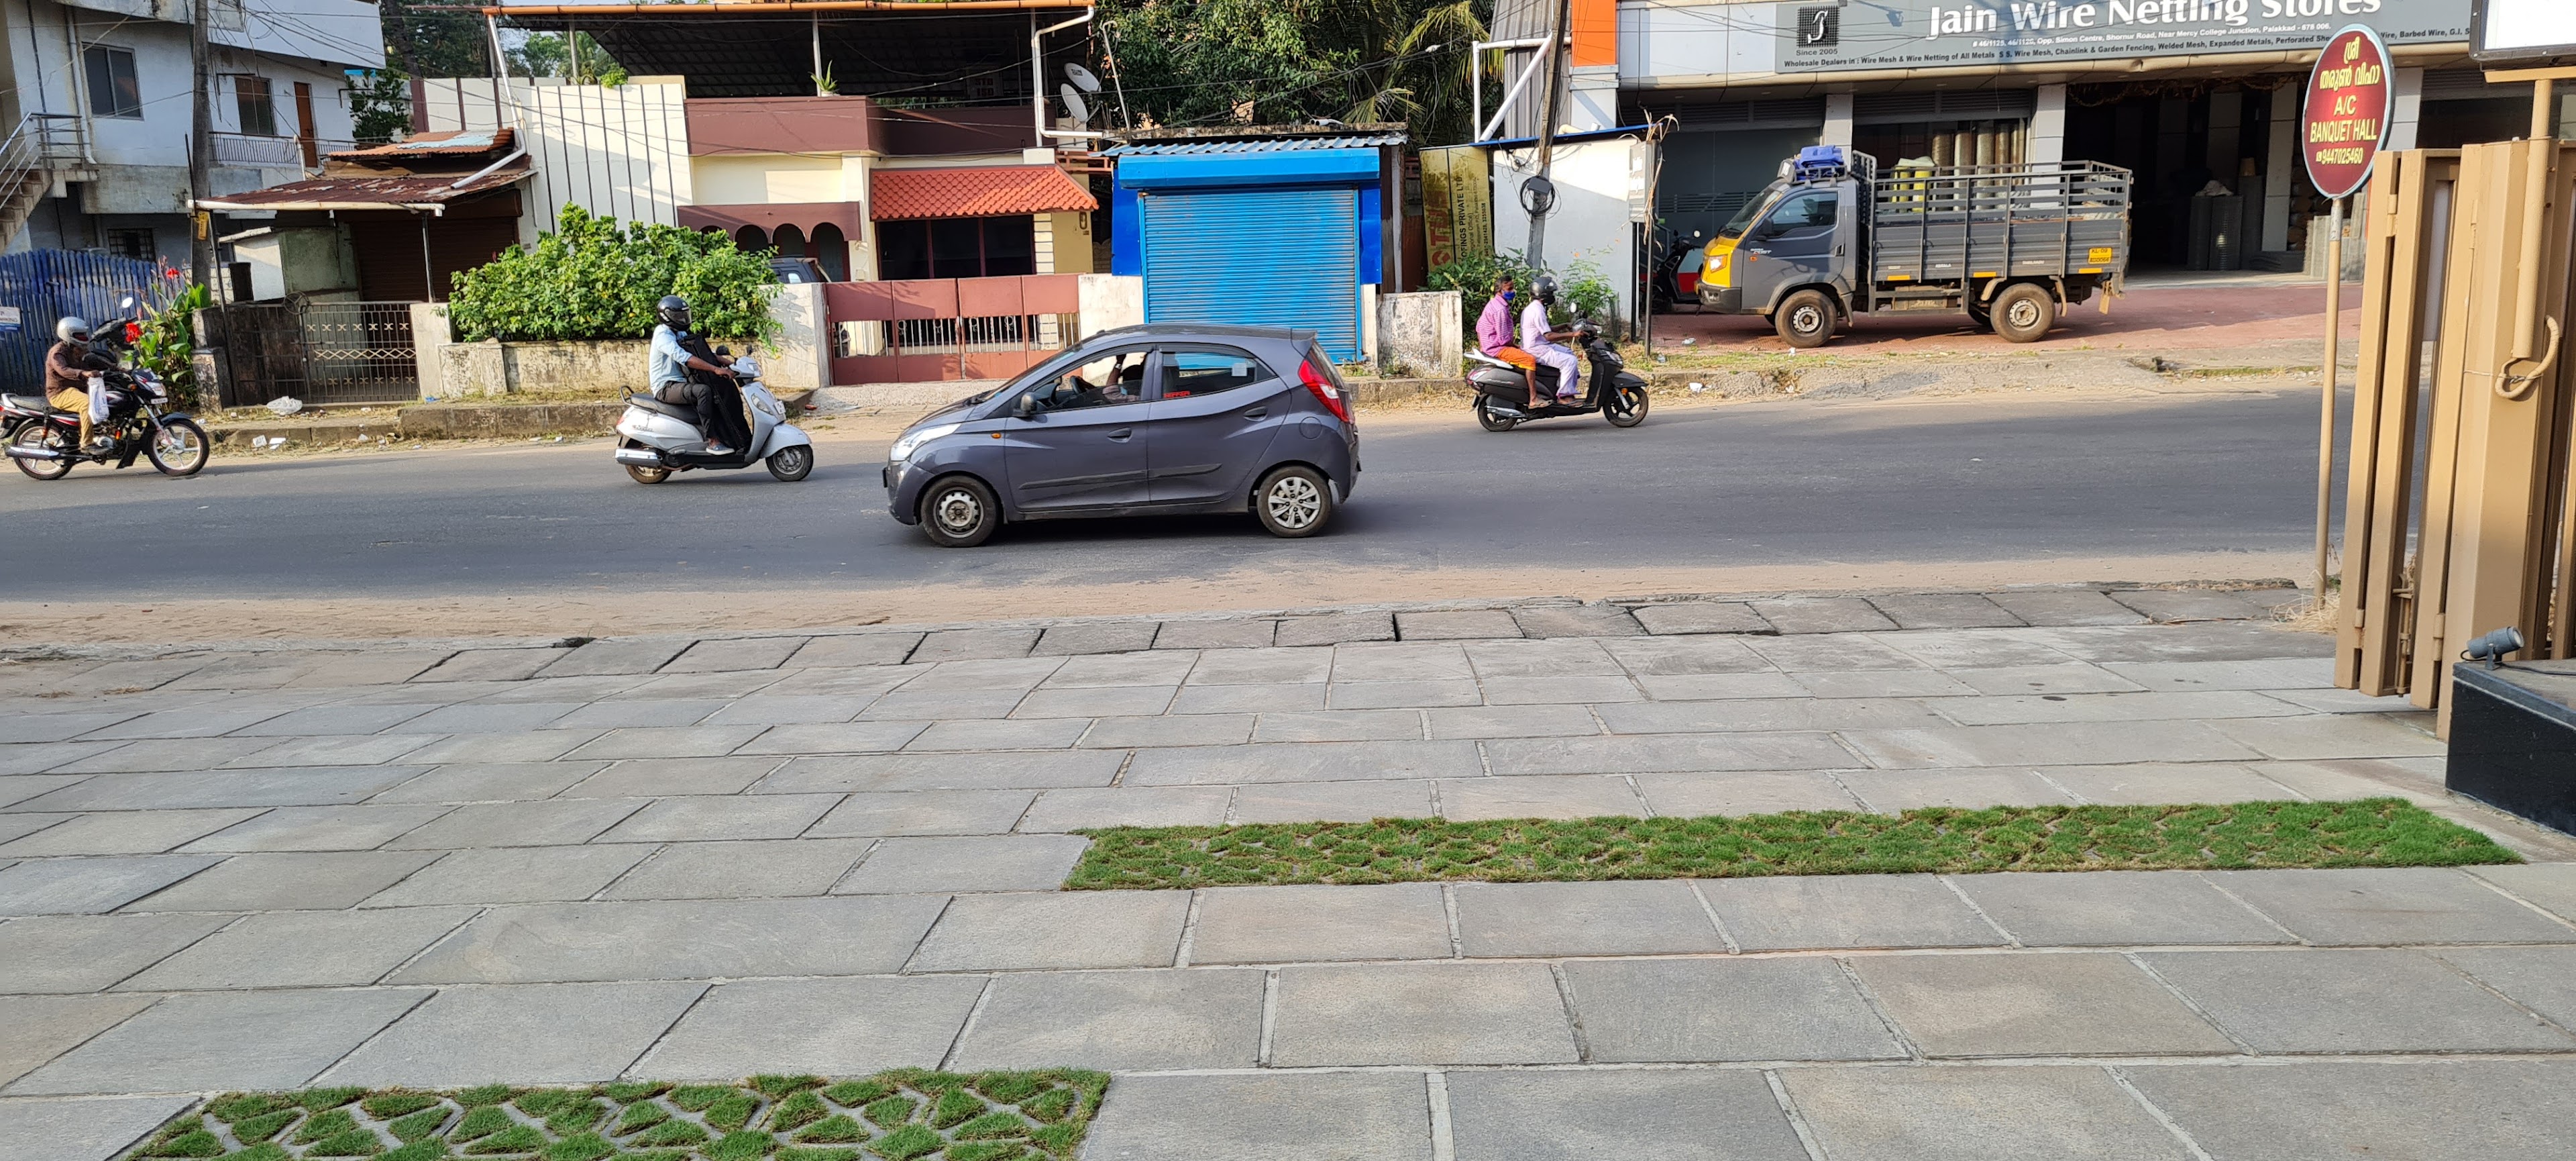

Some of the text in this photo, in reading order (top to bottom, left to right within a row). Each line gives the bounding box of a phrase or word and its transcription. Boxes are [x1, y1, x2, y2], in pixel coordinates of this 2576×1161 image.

[1925, 0, 2381, 40] Jain Wire Netting Stores
[1784, 59, 1819, 67] Wholesale
[1821, 58, 1847, 66] Dealers
[2055, 47, 2088, 55] Chainlink
[2126, 44, 2155, 52] Fencing,
[2210, 39, 2245, 48] Expanded
[2276, 36, 2314, 44] Perforated
[2428, 29, 2447, 37] Wire,
[2037, 37, 2054, 45] Opp.
[2177, 30, 2199, 38] Mercy
[2200, 28, 2226, 36] College
[2344, 36, 2361, 64] ശ്രീ
[2333, 95, 2357, 115] A/C
[2310, 119, 2377, 144] BANQUET HALL
[2322, 148, 2364, 164] 9447025460
[1457, 193, 1466, 225] PRIVATE
